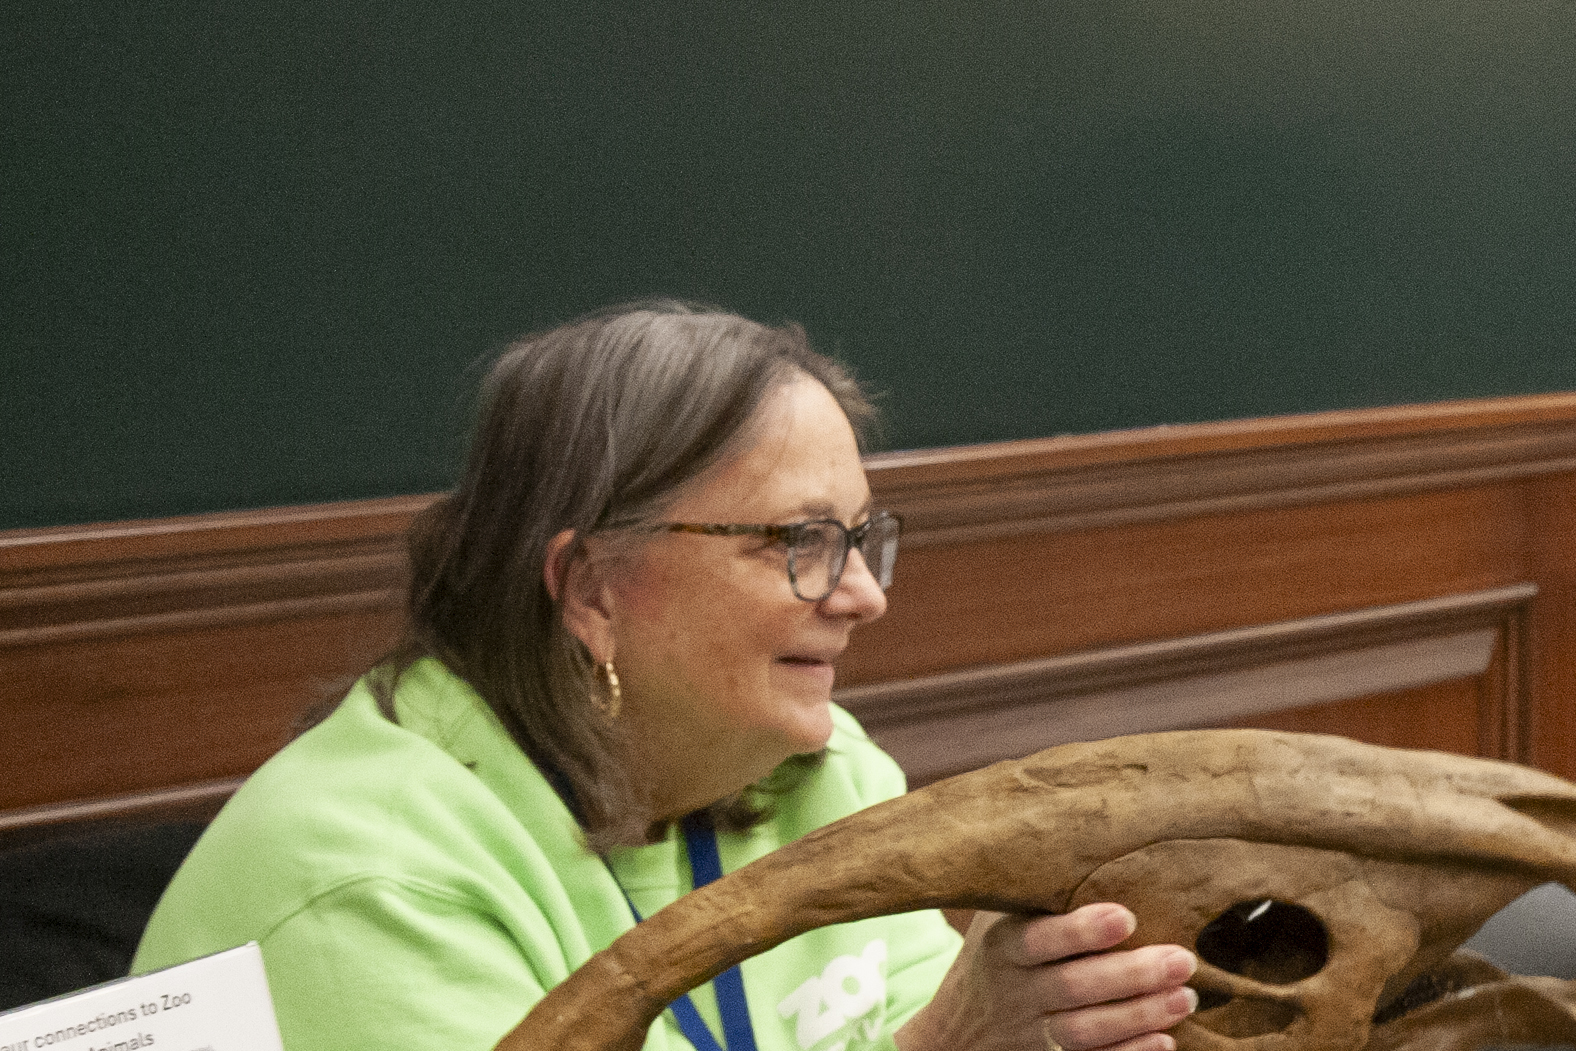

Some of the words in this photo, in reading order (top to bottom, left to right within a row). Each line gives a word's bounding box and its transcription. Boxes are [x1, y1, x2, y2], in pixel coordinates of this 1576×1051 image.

[34, 1008, 137, 1049] connections
[140, 1003, 157, 1016] to
[160, 992, 191, 1011] Zoo
